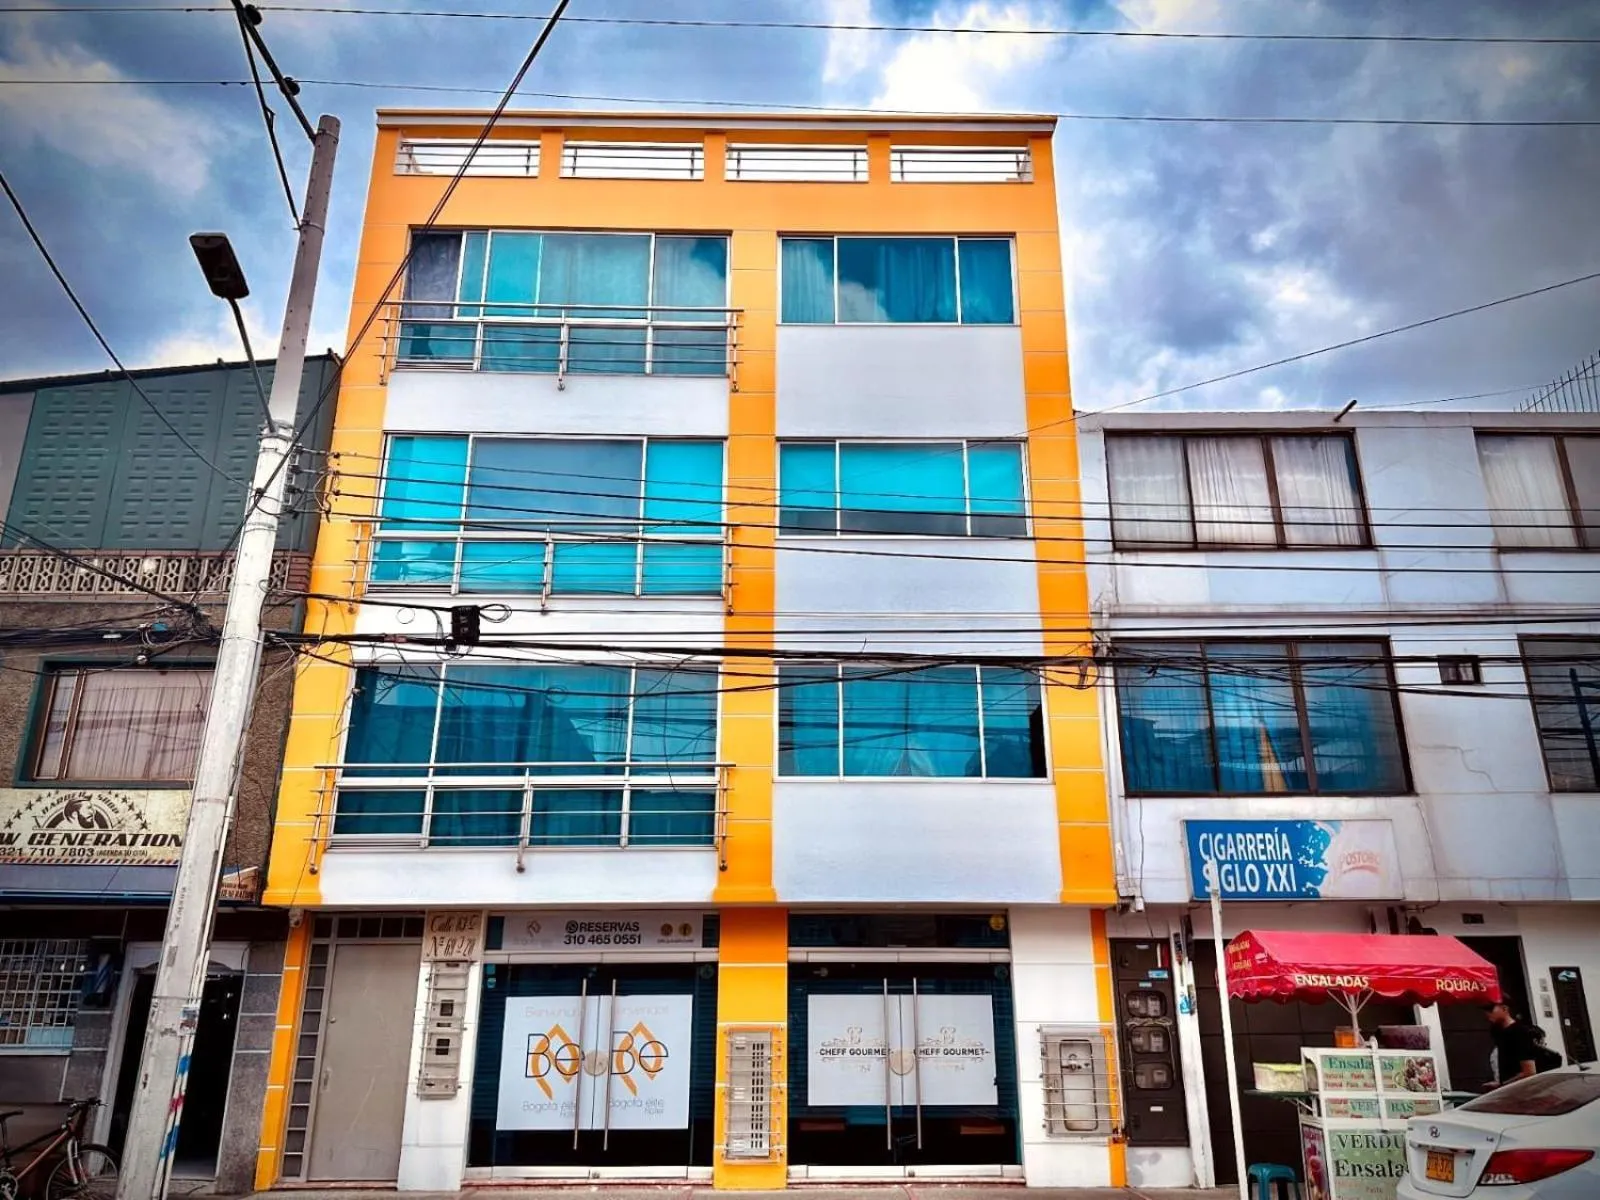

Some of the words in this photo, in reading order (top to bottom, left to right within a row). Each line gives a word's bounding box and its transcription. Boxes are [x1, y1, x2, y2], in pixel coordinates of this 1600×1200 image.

[27, 832, 183, 847] GENERATION
[1199, 827, 1292, 861] CIGARRERÍA
[29, 848, 56, 857] 710
[60, 848, 94, 857] 7803
[1264, 863, 1297, 892] XXI
[580, 922, 640, 932] RESERVAS
[564, 935, 585, 944] 310
[588, 934, 611, 944] 465
[613, 934, 641, 944] 0551
[1294, 975, 1369, 988] ENSALADAS
[819, 1048, 847, 1056] CHEFF
[943, 1048, 985, 1056] GOURMET
[1335, 1159, 1409, 1178] Ensala
